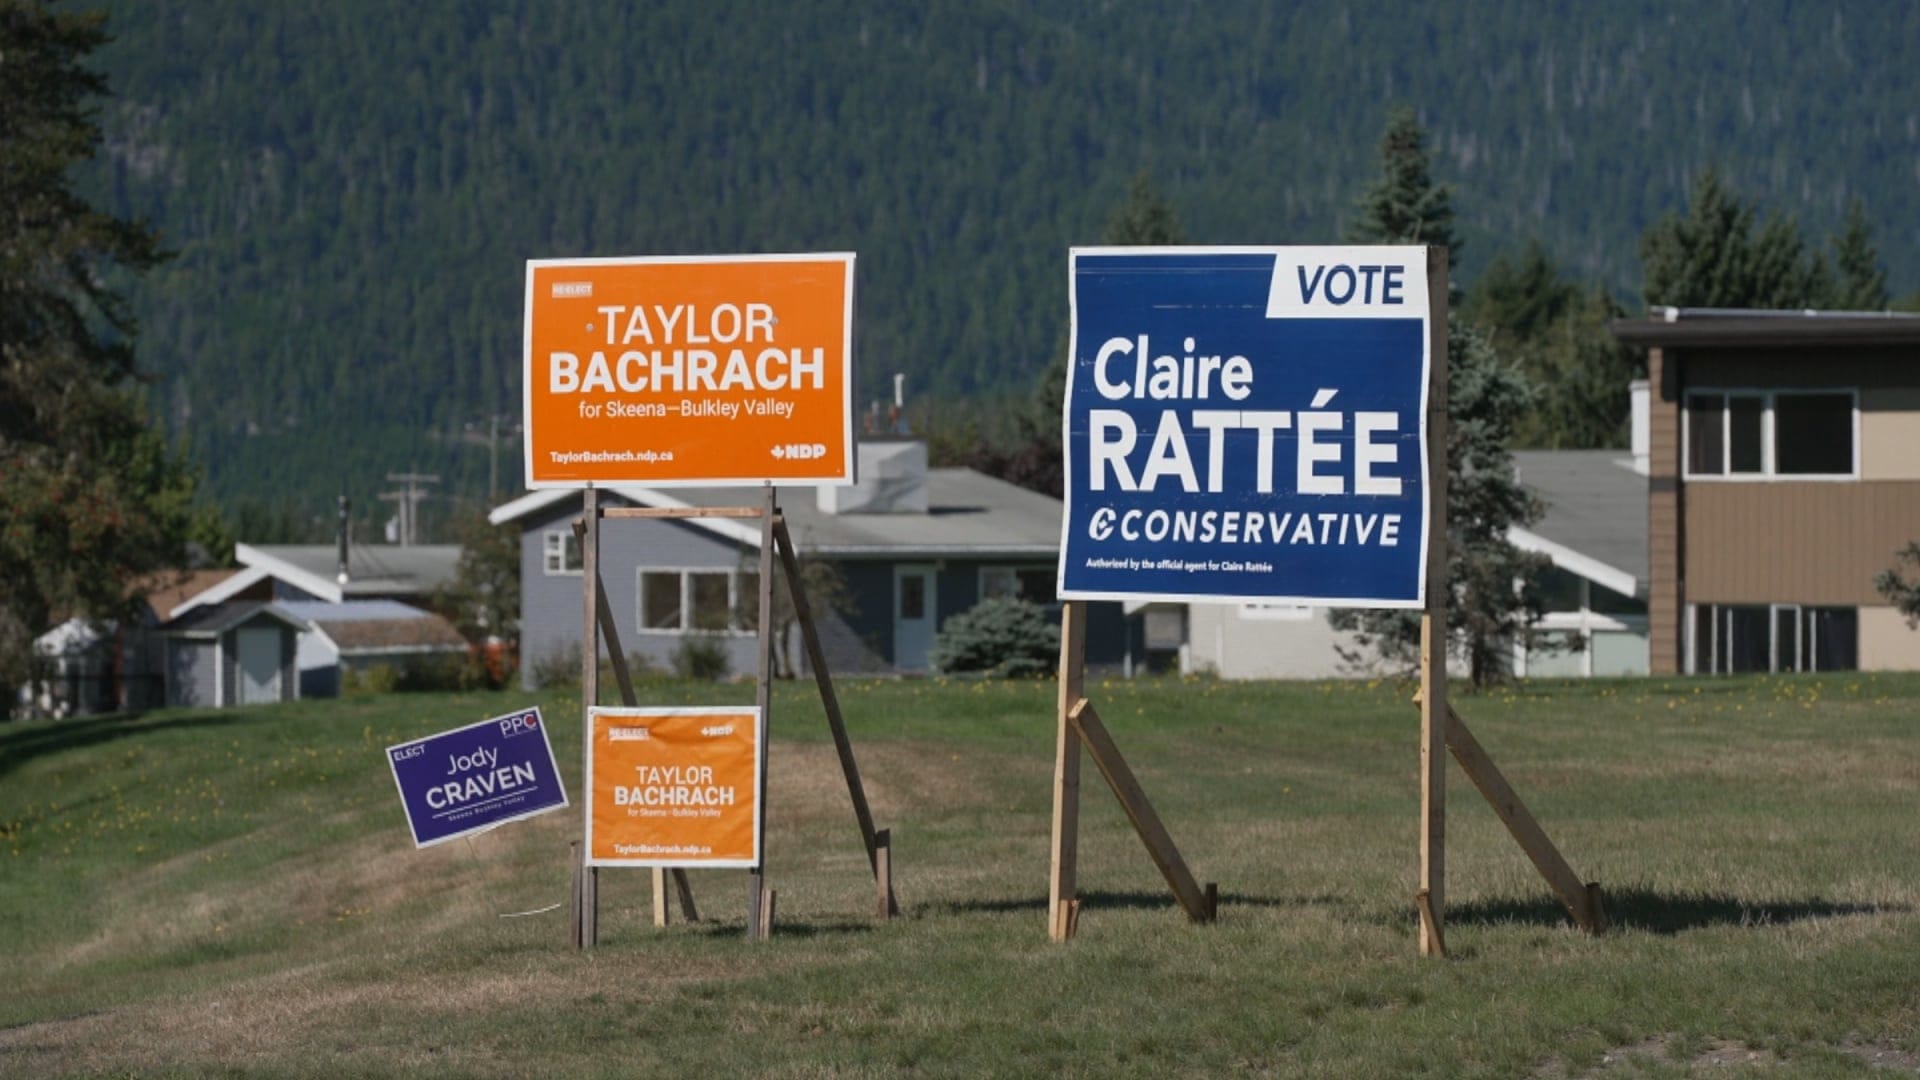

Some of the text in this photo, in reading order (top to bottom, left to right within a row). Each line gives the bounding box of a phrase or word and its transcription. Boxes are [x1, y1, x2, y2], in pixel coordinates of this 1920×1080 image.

[1297, 265, 1404, 305] VOTE
[597, 303, 775, 345] TAYLOR
[550, 347, 824, 393] BACHRACH
[1094, 334, 1253, 400] Claire
[579, 400, 602, 418] for
[744, 397, 794, 419] Valley
[785, 443, 826, 459] NDP
[1089, 388, 1402, 496] RATTÉE
[550, 449, 673, 465] TaylorBachrach.ndp.ca
[1121, 509, 1402, 547] CONSERVATIVE
[1086, 557, 1273, 573] Authorized by the official agent for Claire Rattée
[500, 714, 537, 736] PPC
[394, 744, 425, 761] ELECT
[447, 746, 498, 775] Jody
[426, 761, 536, 809] CRAVEN
[636, 766, 713, 785] TAYLOR
[614, 786, 735, 806] BACHRACH
[628, 808, 638, 817] for
